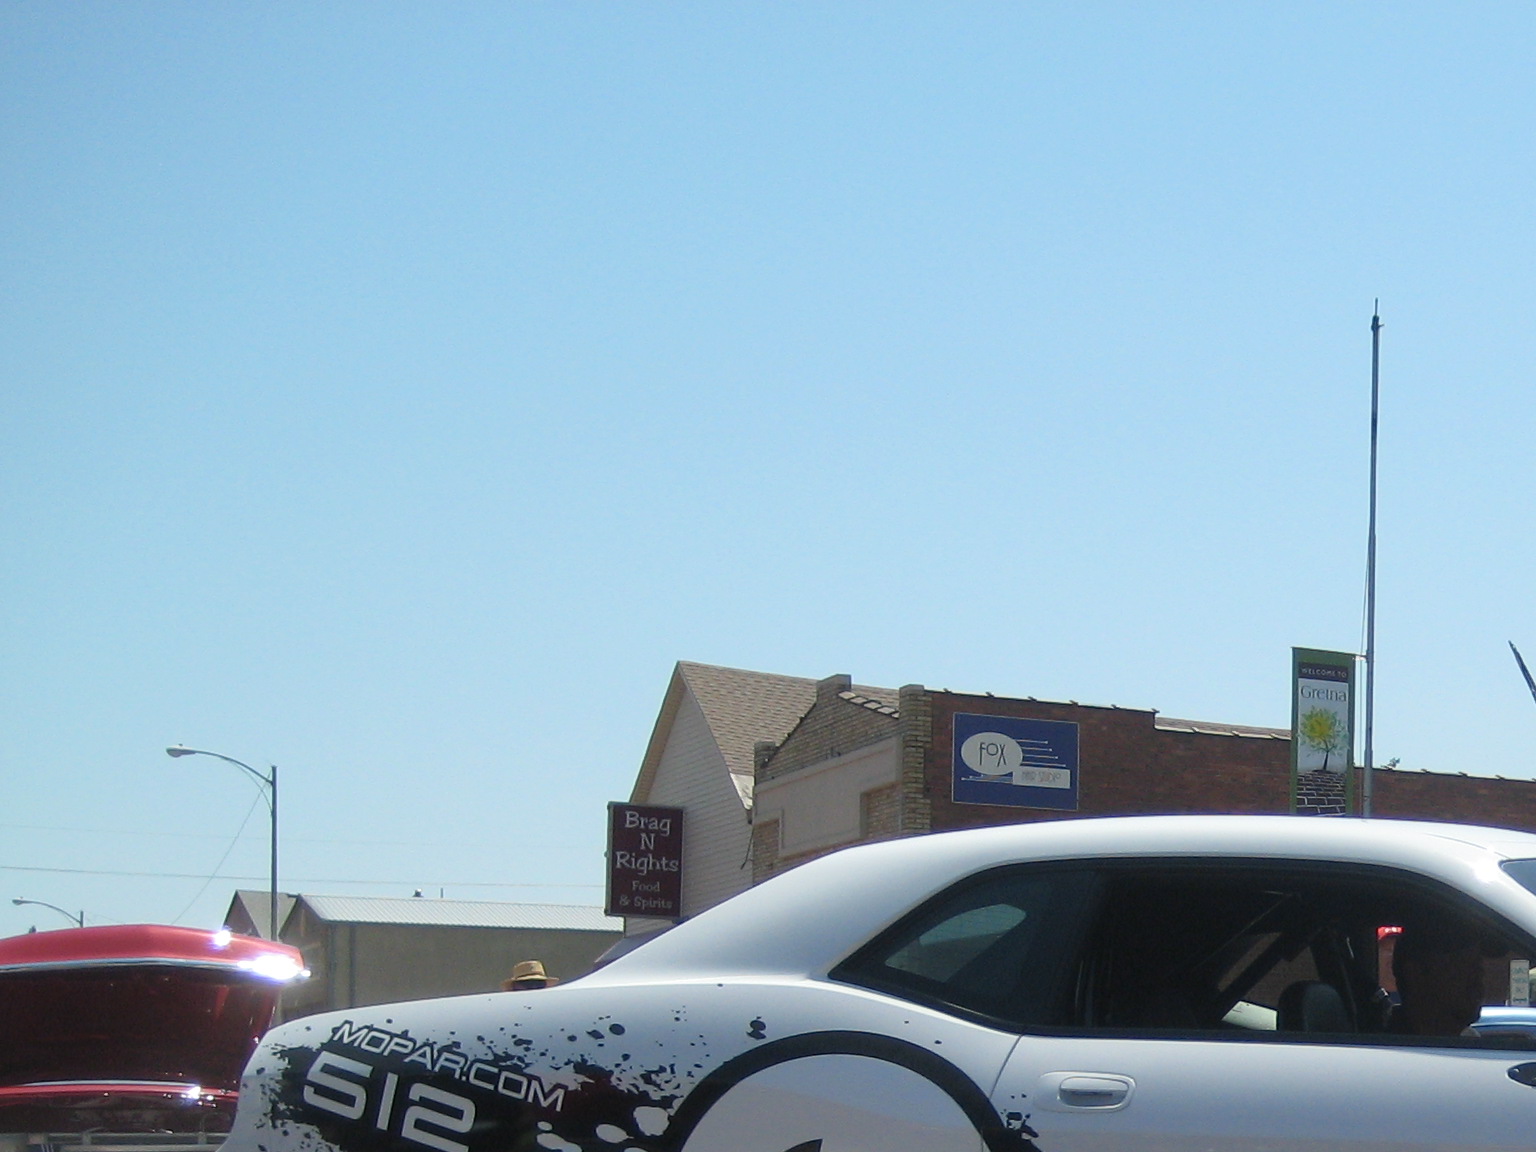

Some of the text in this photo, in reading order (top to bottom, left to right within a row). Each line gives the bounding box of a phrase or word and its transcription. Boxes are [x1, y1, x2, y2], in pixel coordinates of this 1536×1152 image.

[1301, 667, 1347, 678] WELCOME TO
[1301, 685, 1347, 702] Gretna
[979, 742, 1007, 767] FOX
[625, 811, 671, 837] Brag
[640, 833, 656, 850] N
[616, 851, 679, 875] Rights
[632, 881, 660, 892] Food
[634, 897, 672, 909] Spirits
[332, 1023, 566, 1112] MOPAR.COM
